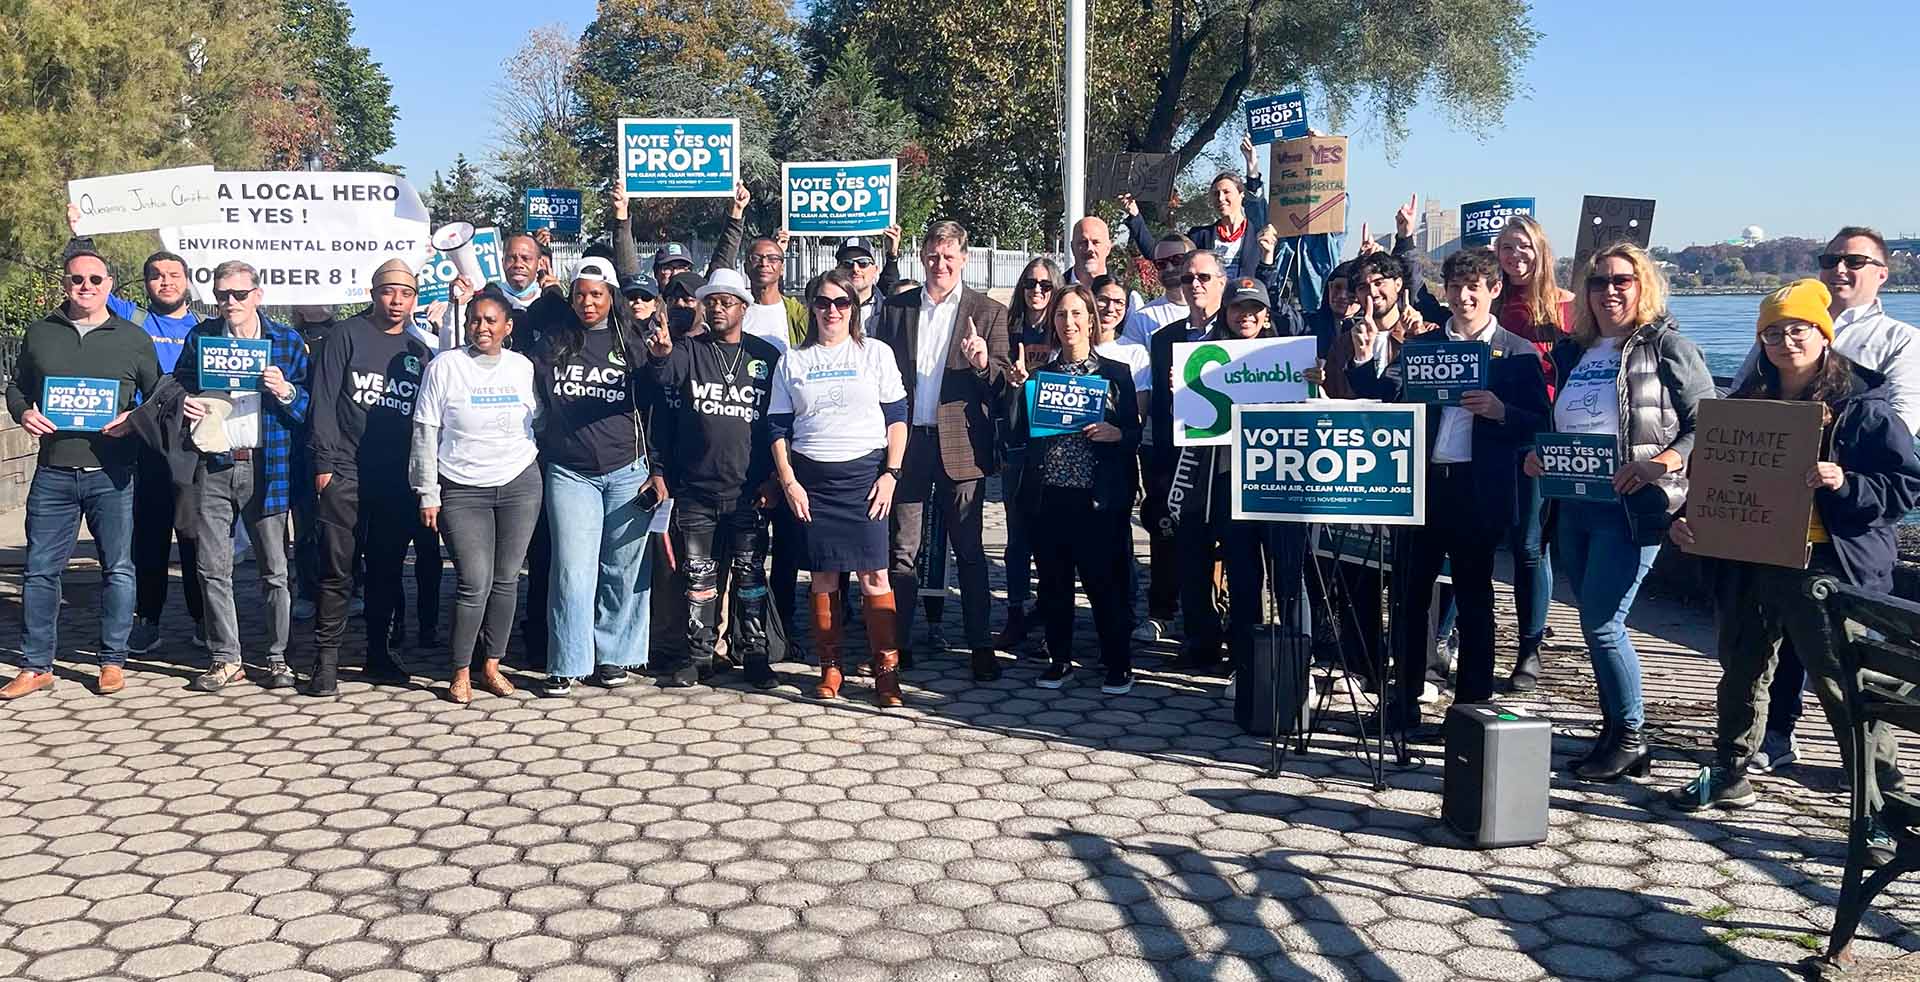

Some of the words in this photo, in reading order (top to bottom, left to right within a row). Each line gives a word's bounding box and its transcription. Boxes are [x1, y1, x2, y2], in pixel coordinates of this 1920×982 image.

[1250, 107, 1270, 116] VOTE
[1251, 110, 1293, 127] PROP
[1296, 107, 1303, 118] 1
[626, 134, 670, 148] VOTE
[673, 134, 704, 148] YES
[708, 134, 732, 148] ON
[628, 148, 712, 171] PROP
[719, 148, 730, 171] 1
[1310, 144, 1343, 165] YES
[790, 178, 832, 190] VOTE
[836, 176, 864, 189] YES
[868, 175, 890, 188] ON
[218, 183, 232, 200] A
[242, 183, 324, 200] LOCAL
[332, 184, 400, 201] HERO
[792, 190, 871, 212] PROP
[878, 188, 888, 209] 1
[248, 208, 294, 224] YES
[303, 208, 308, 224] !
[530, 203, 569, 215] PROP
[572, 206, 578, 215] 1
[1466, 210, 1491, 220] VOTE
[1493, 208, 1512, 216] YES
[179, 238, 326, 251] ENVIRONMENTAL
[332, 240, 378, 252] BOND
[384, 240, 416, 251] ACT
[474, 242, 496, 255] ON
[188, 268, 320, 285] OMBER
[329, 269, 342, 285] 8
[352, 269, 357, 284] !
[420, 260, 459, 285] RO
[484, 254, 498, 277] 1
[203, 347, 228, 356] VOTE
[230, 348, 250, 357] YES
[251, 349, 266, 358] ON
[1406, 356, 1435, 364] VOTE
[1436, 355, 1458, 363] YES
[1461, 353, 1478, 362] ON
[203, 355, 254, 370] PROP
[258, 358, 266, 371] 1
[1407, 364, 1464, 380] PROP
[1470, 363, 1478, 378] 1
[554, 365, 584, 381] WE
[352, 372, 383, 392] WE
[1041, 382, 1067, 392] VOTE
[1069, 385, 1087, 394] YES
[1089, 388, 1104, 396] ON
[49, 386, 76, 395] VOTE
[78, 388, 97, 396] YES
[691, 380, 723, 400] WE
[725, 386, 766, 406] ACT
[48, 394, 101, 408] PROP
[106, 397, 113, 409] 1
[352, 390, 411, 415] 4Chang
[1039, 390, 1090, 408] PROP
[1095, 397, 1102, 410] 1
[1243, 428, 1309, 446] VOTE
[1315, 428, 1365, 447] YES
[1372, 429, 1411, 447] ON
[1706, 427, 1792, 450] CLIMATE
[1542, 445, 1572, 455] VOTE
[1573, 447, 1594, 456] YES
[1597, 448, 1613, 457] ON
[1704, 448, 1787, 468] JUSTICE
[1246, 448, 1377, 483] PROP
[1390, 450, 1408, 483] 1
[1543, 455, 1600, 473] PROP
[1606, 458, 1614, 474] 1
[1334, 486, 1367, 494] WATER,
[1706, 488, 1765, 507] RACIAL
[1696, 505, 1774, 524] JUSTICE
